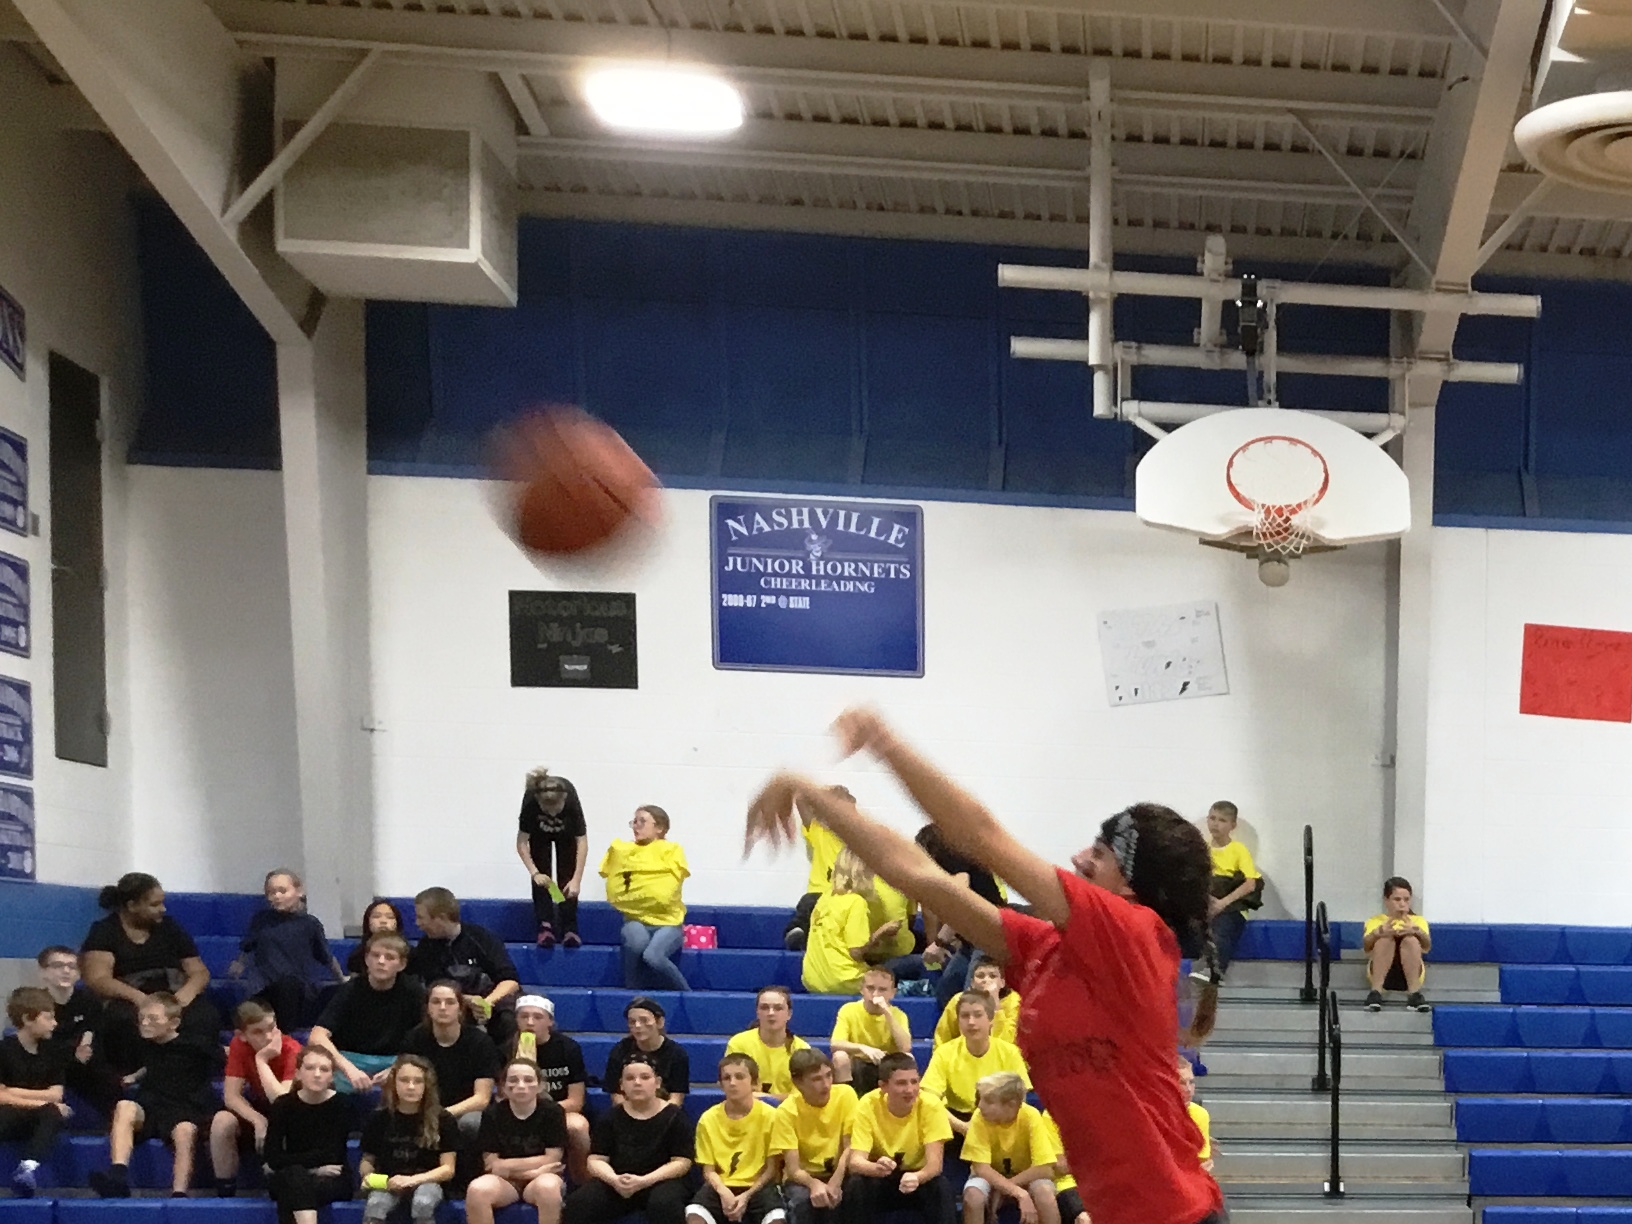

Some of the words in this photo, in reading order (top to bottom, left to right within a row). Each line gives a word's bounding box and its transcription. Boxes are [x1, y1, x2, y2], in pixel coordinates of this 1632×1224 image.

[725, 507, 909, 548] NASHVILLE
[724, 556, 805, 575] JUNIOR
[811, 559, 911, 579] HORNETS
[760, 577, 875, 593] CHEERLEADING
